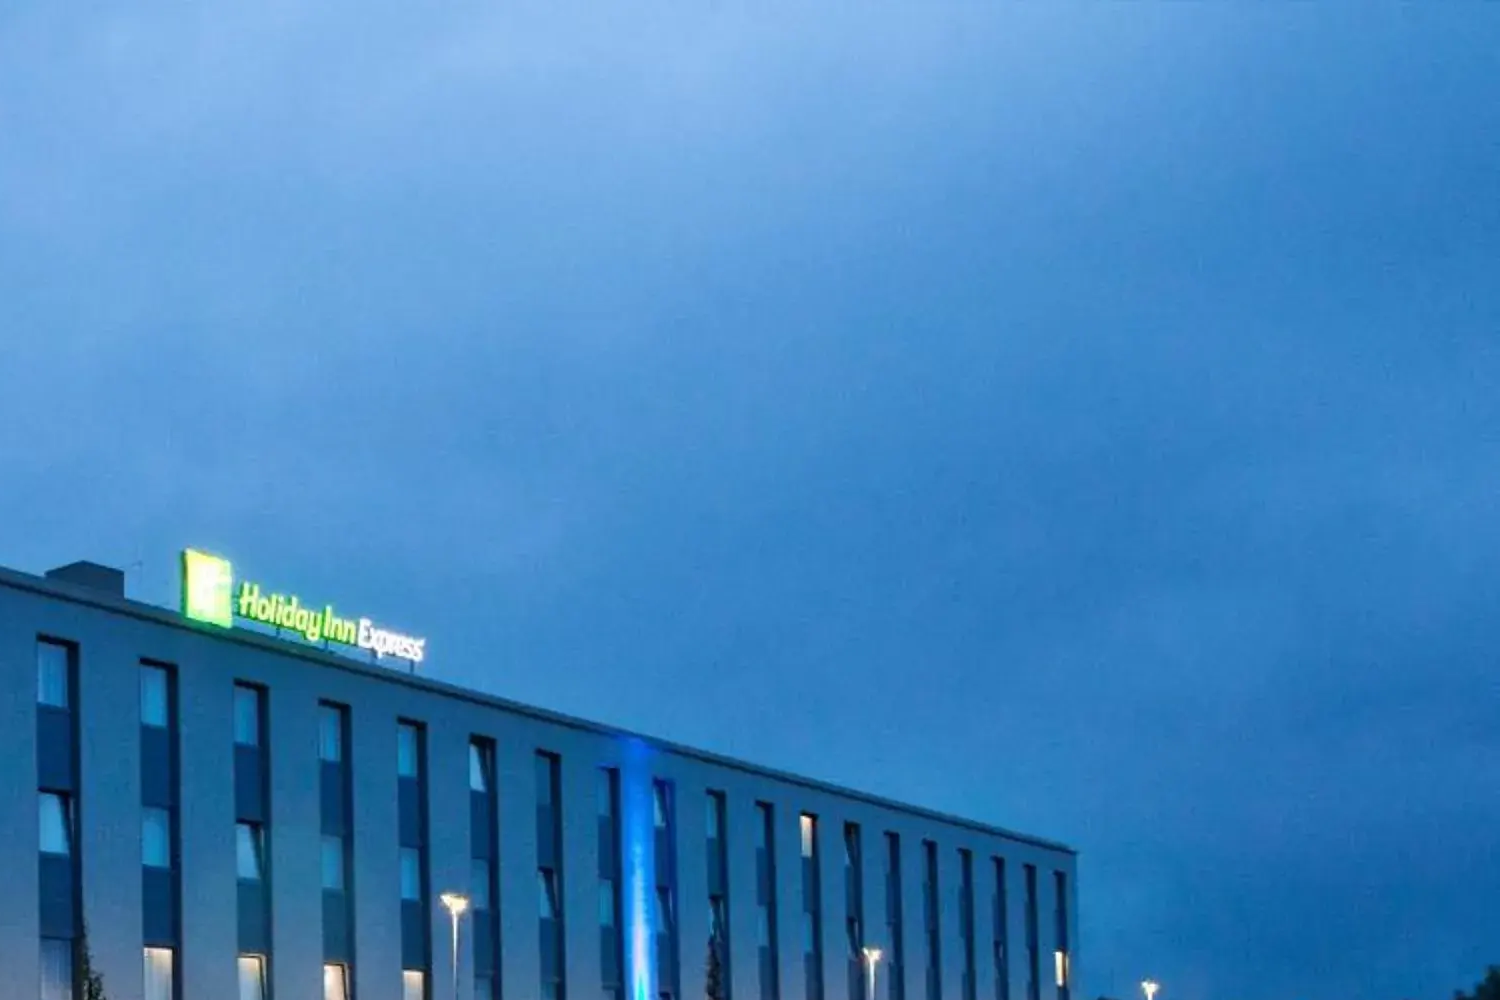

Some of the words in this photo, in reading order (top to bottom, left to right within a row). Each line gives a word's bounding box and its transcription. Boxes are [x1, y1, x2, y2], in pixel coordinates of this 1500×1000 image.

[240, 581, 322, 642] Holiday
[323, 605, 357, 645] Inn
[358, 618, 426, 662] Express
